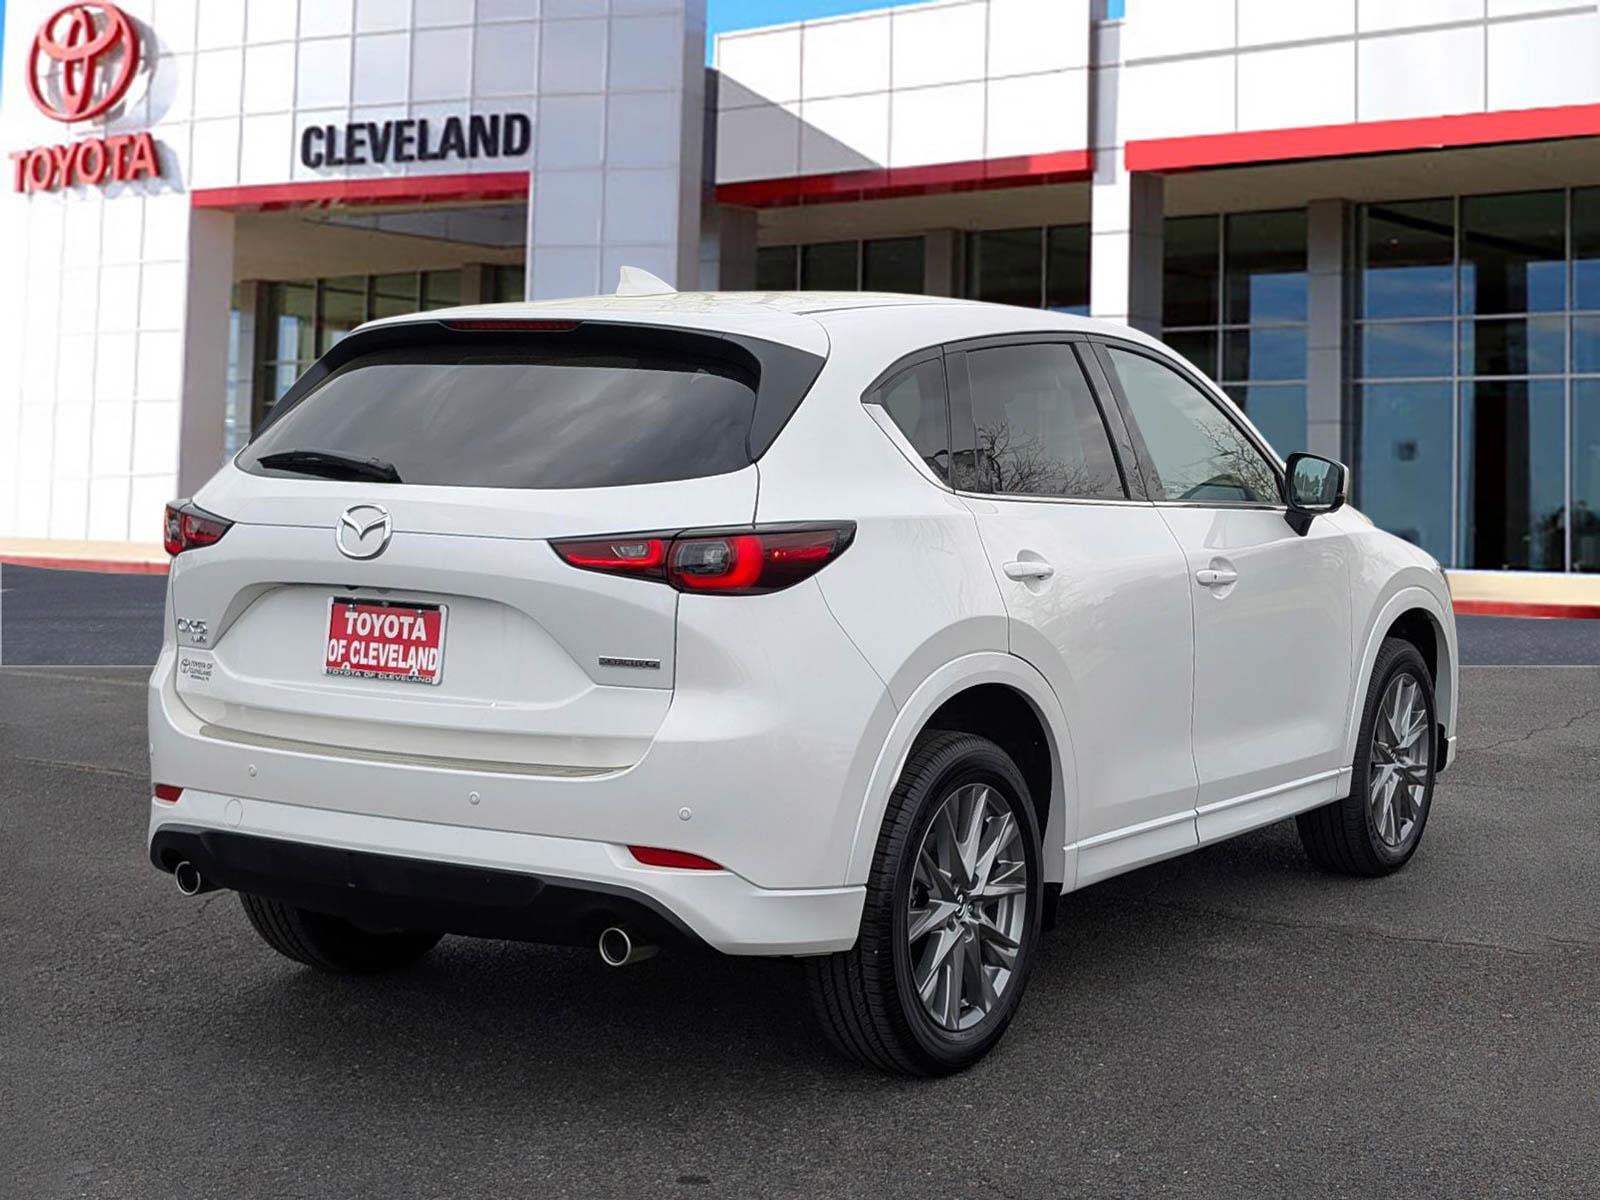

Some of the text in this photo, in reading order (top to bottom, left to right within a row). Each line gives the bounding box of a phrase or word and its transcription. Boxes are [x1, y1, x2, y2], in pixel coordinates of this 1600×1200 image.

[301, 113, 531, 168] CLEVELAND
[9, 132, 160, 193] TOYOTA
[345, 611, 427, 641] TOYOTA
[328, 638, 438, 671] OF CLEVELAND
[327, 668, 361, 678] TOYOTA
[378, 674, 432, 683] CLEVELAND
